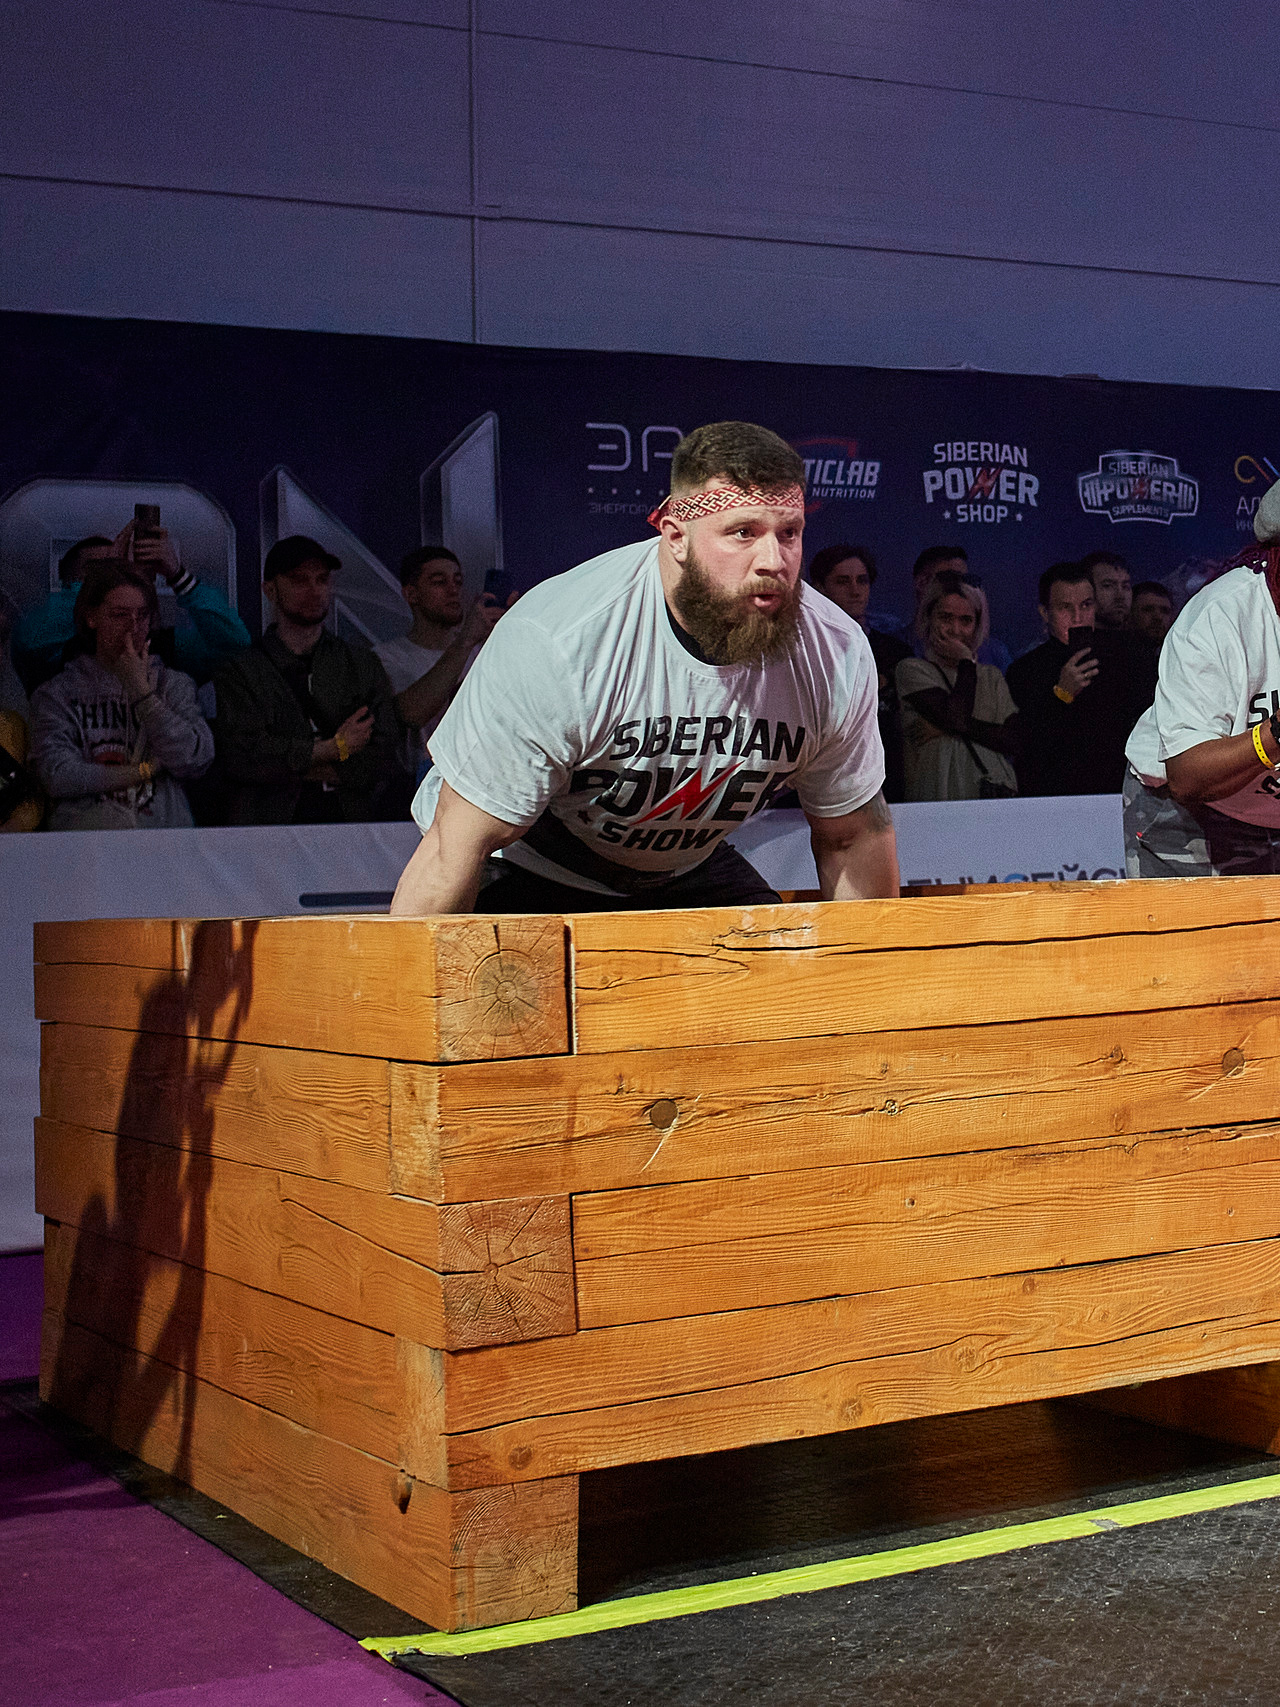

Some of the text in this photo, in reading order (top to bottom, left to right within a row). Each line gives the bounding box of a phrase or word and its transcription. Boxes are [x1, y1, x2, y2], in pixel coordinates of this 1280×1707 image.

[934, 441, 1028, 467] SIBERIAN
[803, 458, 881, 487] TICLAB
[1108, 460, 1169, 478] SIBERIAN
[812, 487, 876, 499] NUTRITION
[923, 467, 1040, 507] POWER
[1102, 477, 1176, 503] POWER
[957, 504, 1008, 523] SHOP
[1111, 504, 1170, 518] SUPPLEMENTS
[609, 715, 806, 763] SIBERIAN
[597, 820, 725, 851] SHOW
